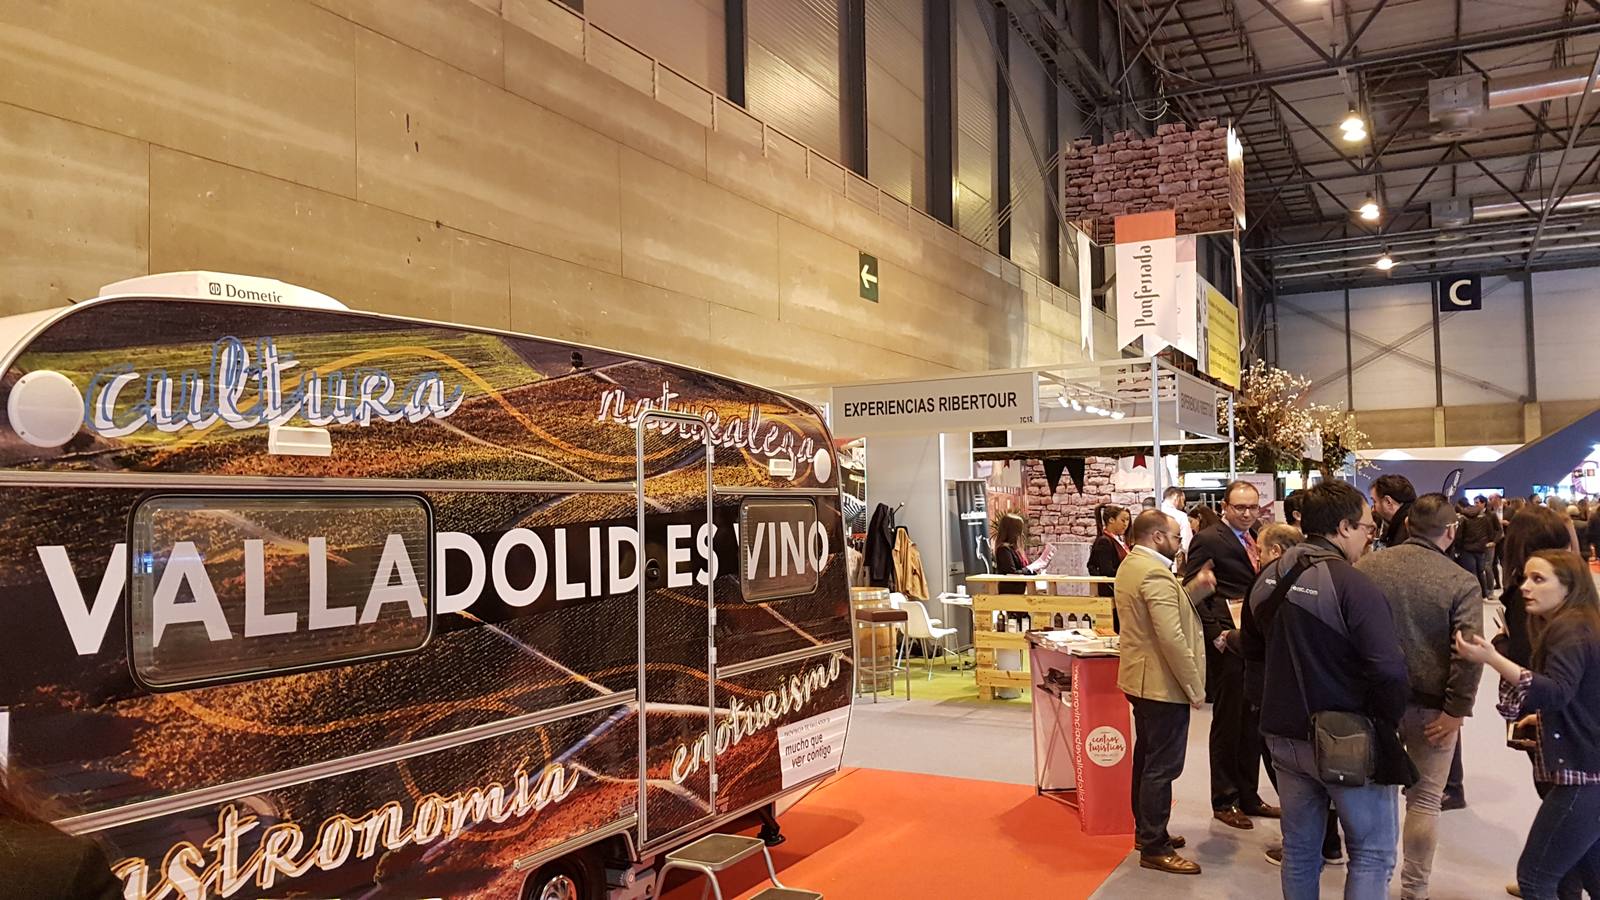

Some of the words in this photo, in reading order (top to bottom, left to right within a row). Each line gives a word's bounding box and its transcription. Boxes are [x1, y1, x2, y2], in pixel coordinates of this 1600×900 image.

[226, 284, 283, 303] Dometic
[1133, 245, 1160, 328] Ponferrada
[1449, 279, 1472, 306] C
[84, 336, 465, 438] cultura
[844, 398, 935, 417] EXPERIENCIAS
[939, 391, 1017, 412] RIBERTOUR
[598, 380, 815, 481] naturaleza
[36, 525, 639, 656] VALLADOLID
[667, 524, 719, 588] ES
[733, 520, 829, 580] VINO
[670, 650, 844, 785] enoturismo
[785, 738, 809, 757] mucho
[810, 734, 823, 749] que
[806, 745, 832, 762] contigo
